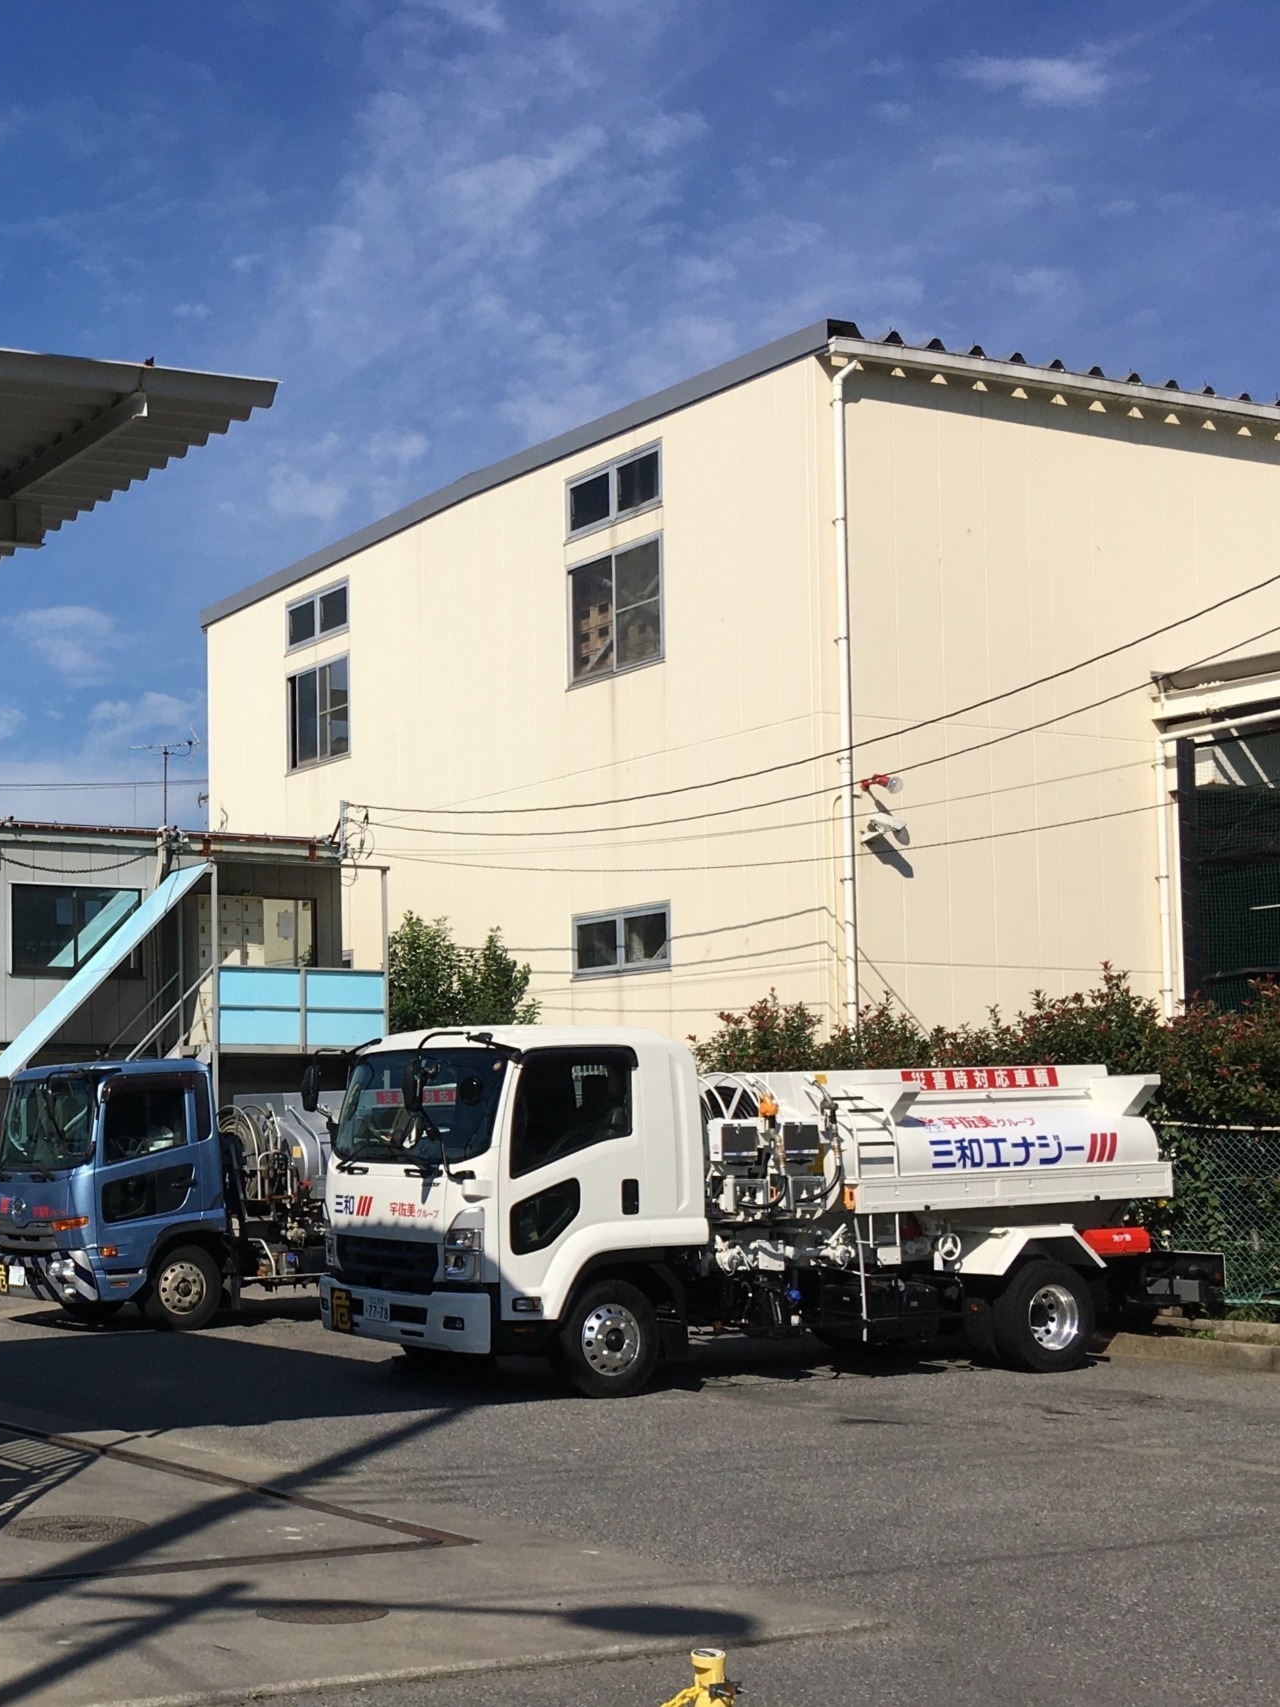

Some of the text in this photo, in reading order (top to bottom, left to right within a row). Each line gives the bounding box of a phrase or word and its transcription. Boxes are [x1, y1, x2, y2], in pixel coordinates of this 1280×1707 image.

[929, 1134, 1086, 1169] 三和エナジー
[334, 1194, 355, 1216] 三和
[332, 1290, 351, 1330] 危
